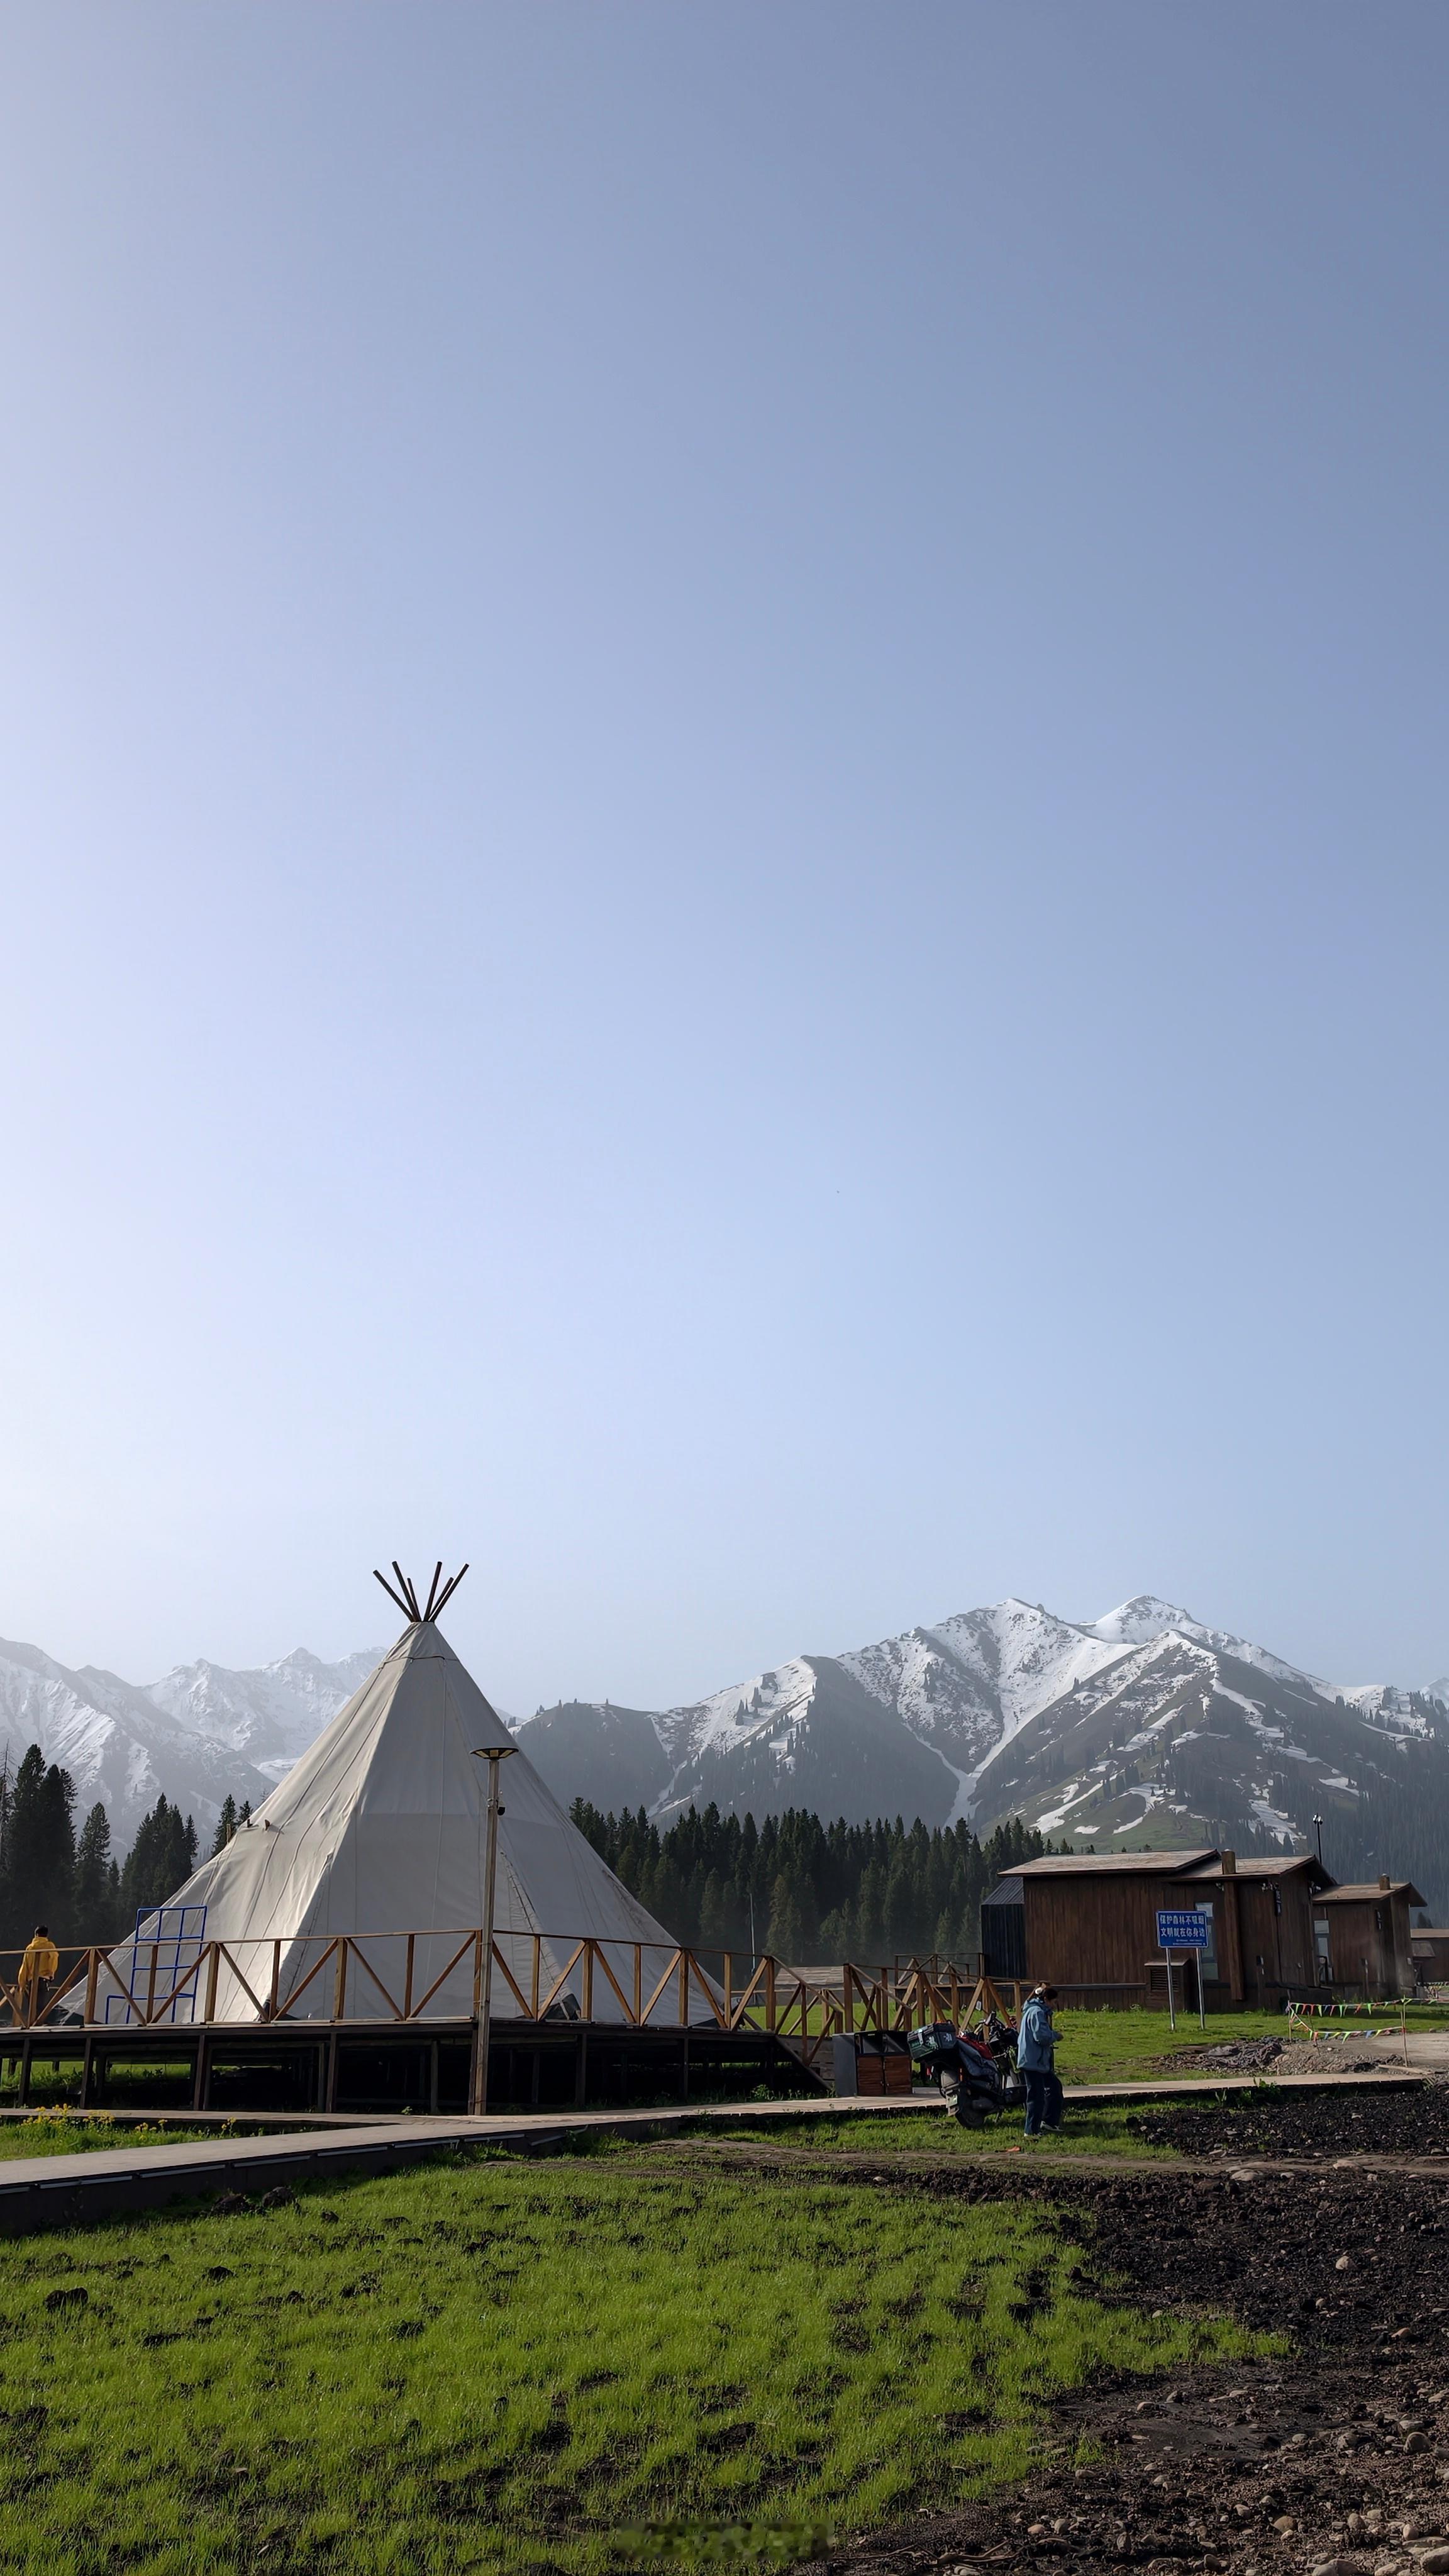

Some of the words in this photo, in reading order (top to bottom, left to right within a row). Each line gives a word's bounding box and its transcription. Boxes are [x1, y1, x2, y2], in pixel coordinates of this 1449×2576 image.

[1161, 1927, 1205, 1937] 文明就在你身边
